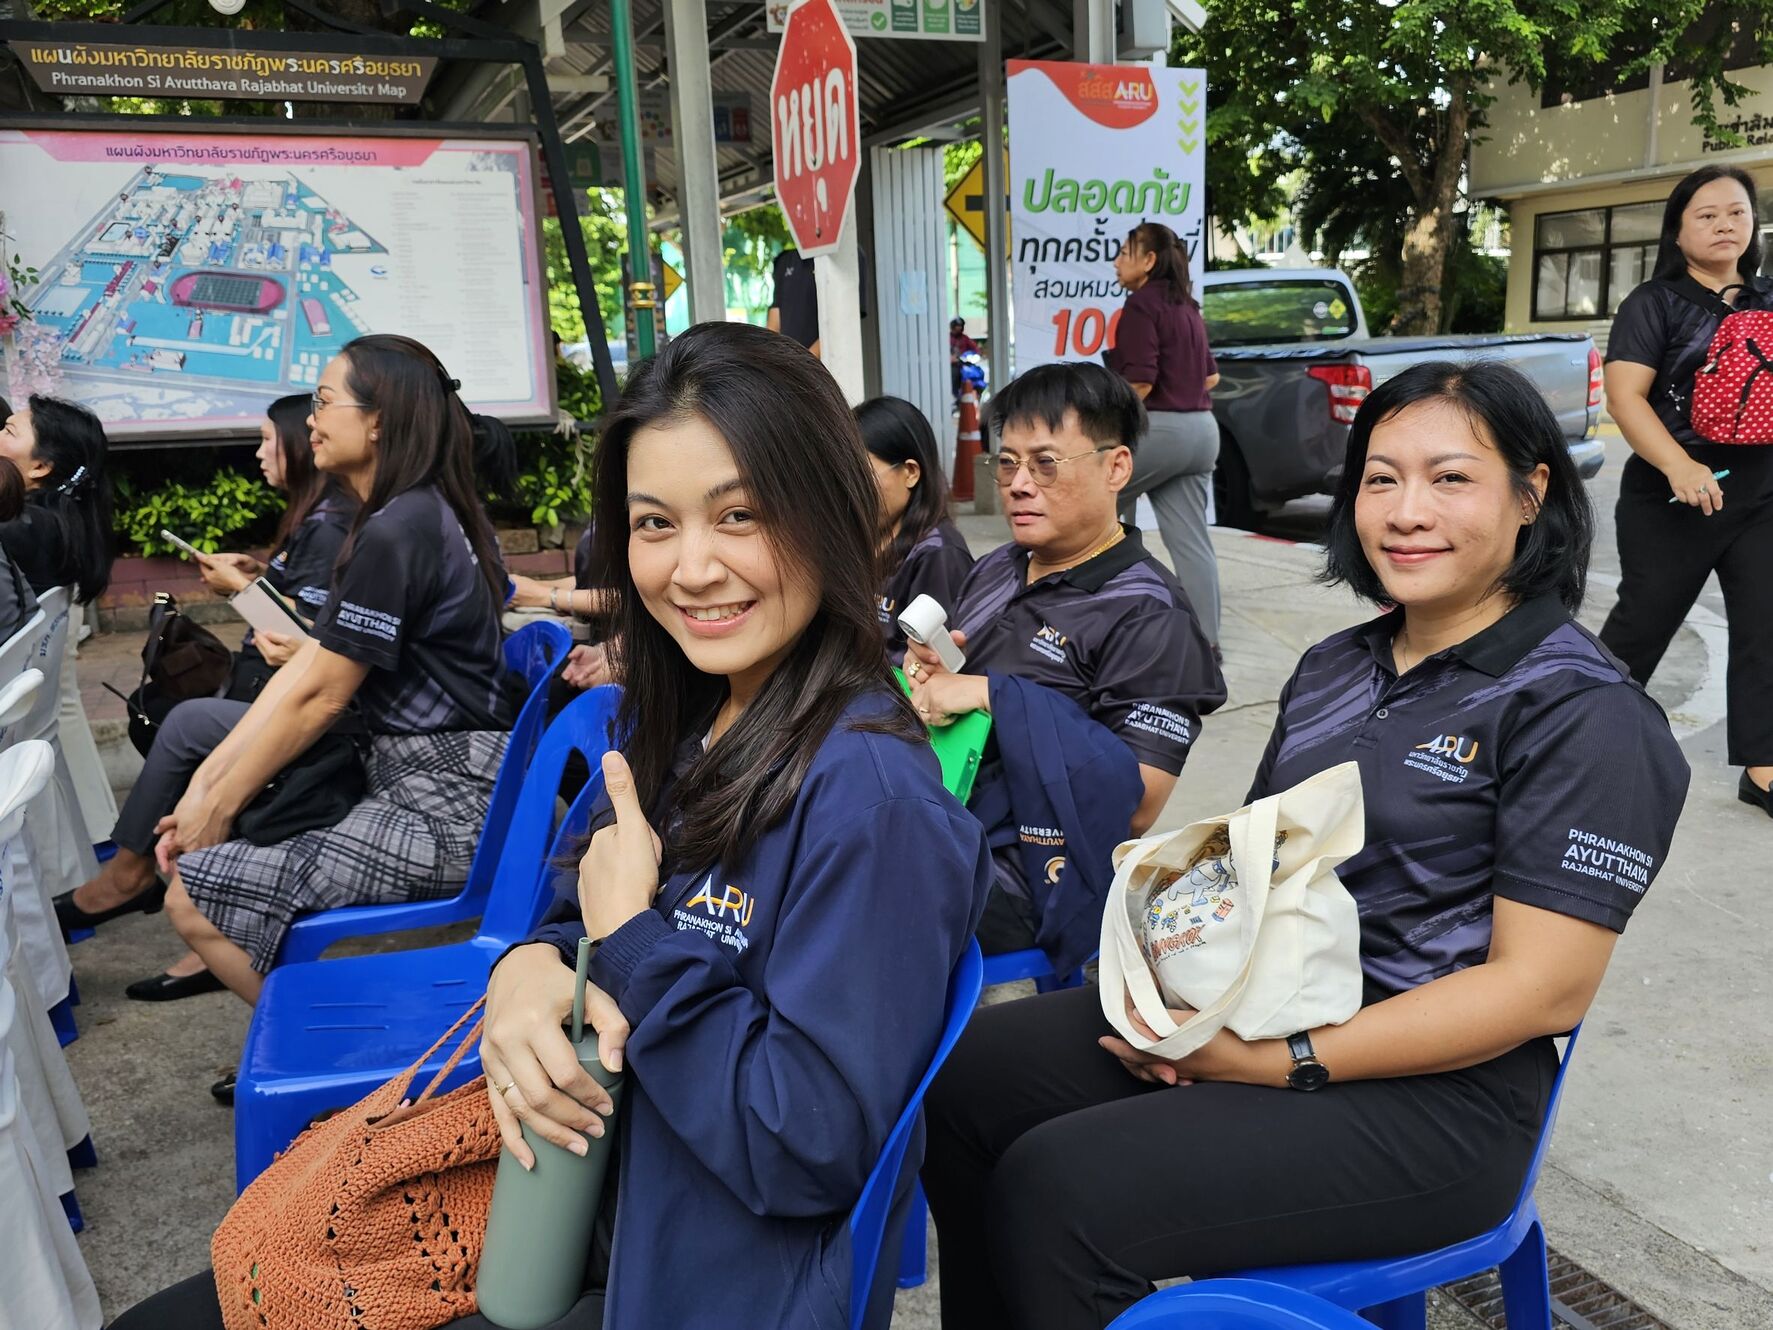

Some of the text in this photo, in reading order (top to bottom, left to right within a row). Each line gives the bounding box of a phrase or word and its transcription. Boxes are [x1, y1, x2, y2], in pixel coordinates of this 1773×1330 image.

[31, 45, 421, 80] แผนผังมหาวิทยาลัยราชภัฏพระนครศรีอยุธยา
[51, 71, 144, 89] Phranakhon
[147, 74, 161, 88] Si
[240, 78, 305, 96] Rajabhat
[377, 83, 407, 98] Map
[1113, 80, 1154, 101] ARU
[778, 67, 849, 213] หยุด
[1022, 167, 1192, 215] ปลอดภัย
[1124, 718, 1159, 734] RAJABHAT
[1127, 710, 1190, 739] AYUTTHAYA
[1415, 733, 1479, 763] ARU
[1019, 833, 1065, 846] AYUTTHAYA
[1568, 828, 1654, 868] PHRANAKHON SI
[1561, 859, 1646, 895] RAJABHAT UNIVERSITY
[1564, 843, 1649, 885] AYUTTHAYA
[686, 873, 755, 927] ARU
[673, 909, 733, 935] PHRANAKHON SI
